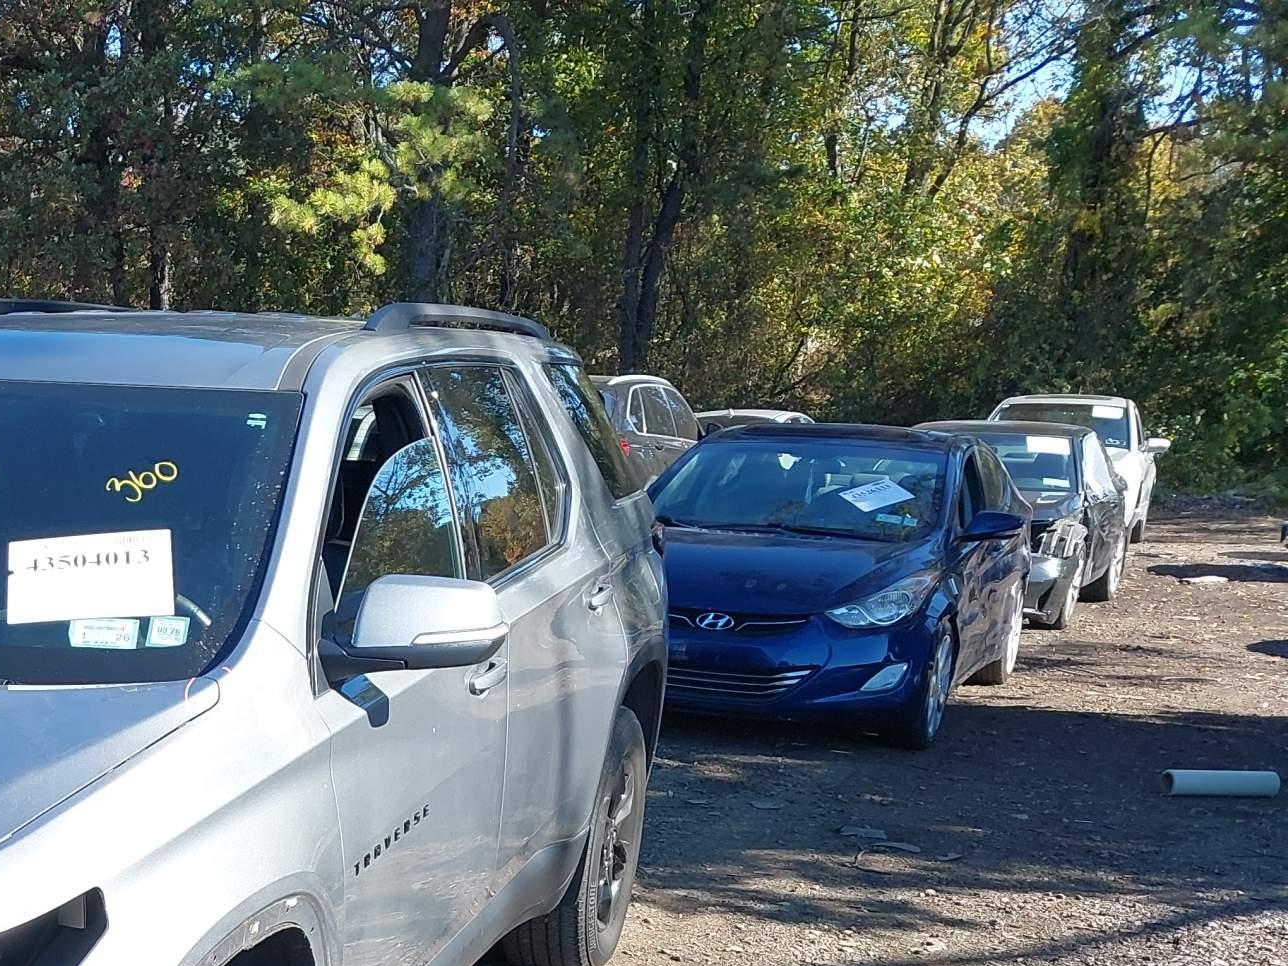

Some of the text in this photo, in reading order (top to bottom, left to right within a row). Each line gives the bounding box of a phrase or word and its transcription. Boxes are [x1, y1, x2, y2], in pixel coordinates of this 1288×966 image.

[105, 461, 178, 502] 360
[25, 549, 150, 572] 43504013
[353, 804, 430, 876] TRAVERSE
